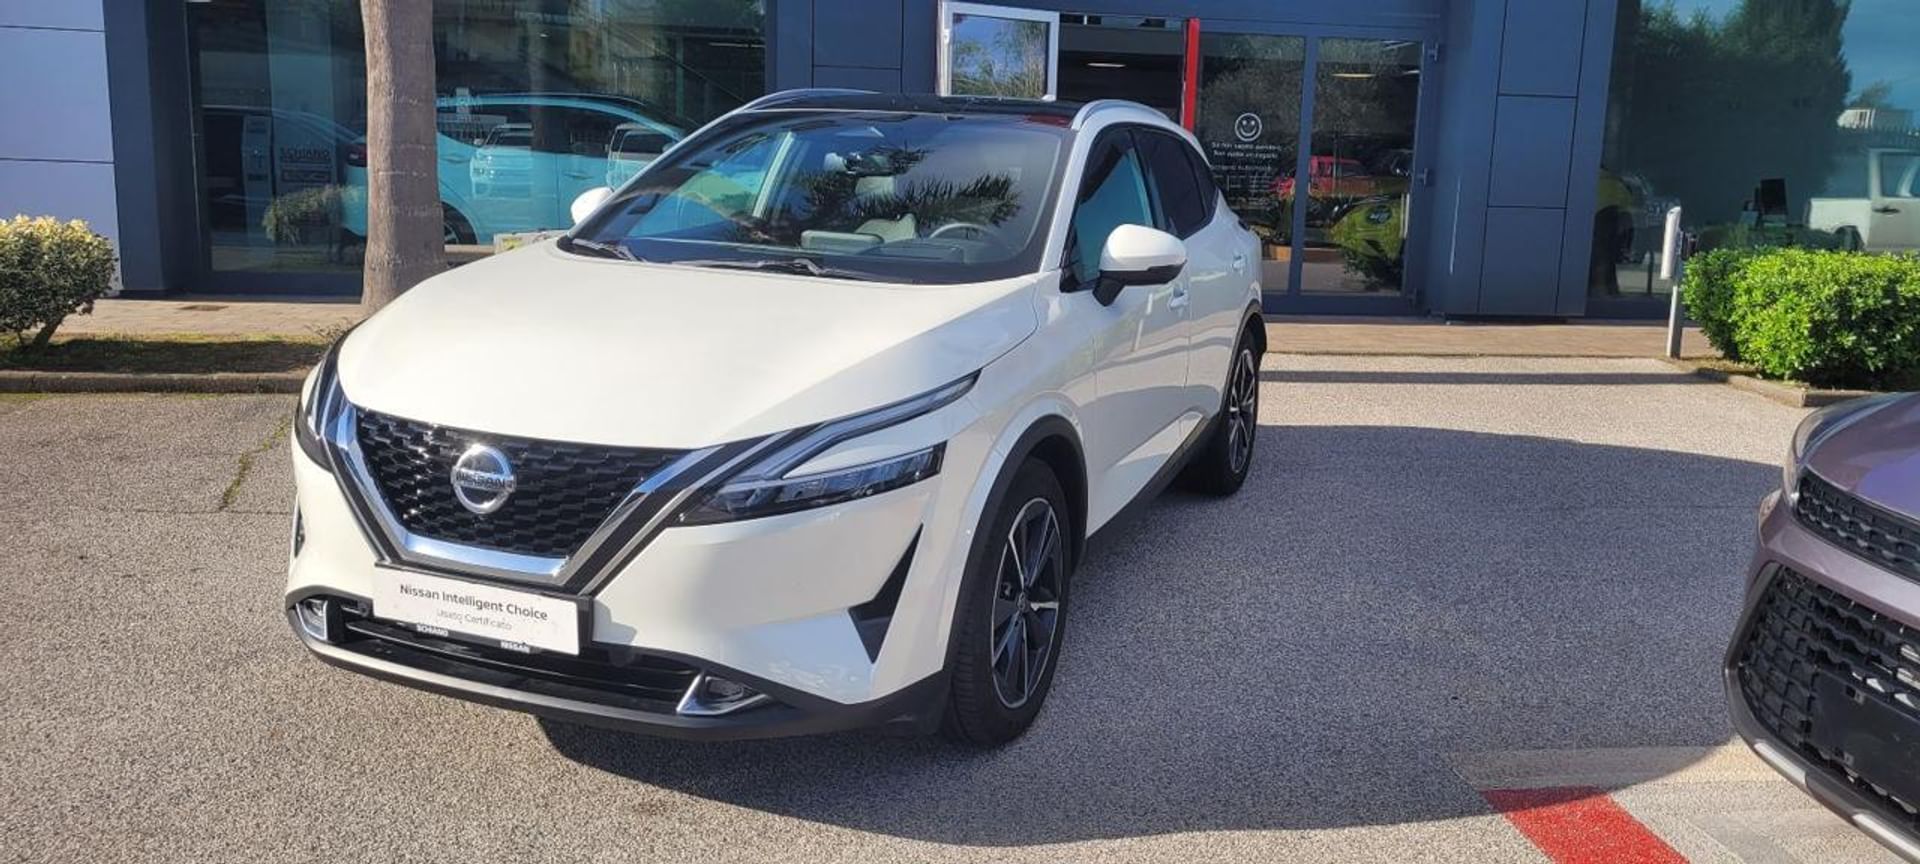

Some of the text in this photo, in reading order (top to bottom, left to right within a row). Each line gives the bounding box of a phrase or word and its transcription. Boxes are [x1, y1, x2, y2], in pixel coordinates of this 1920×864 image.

[456, 471, 505, 489] NISSAN
[400, 584, 548, 620] Nissan Intelligent Choice
[437, 609, 512, 630] Usato Certificato
